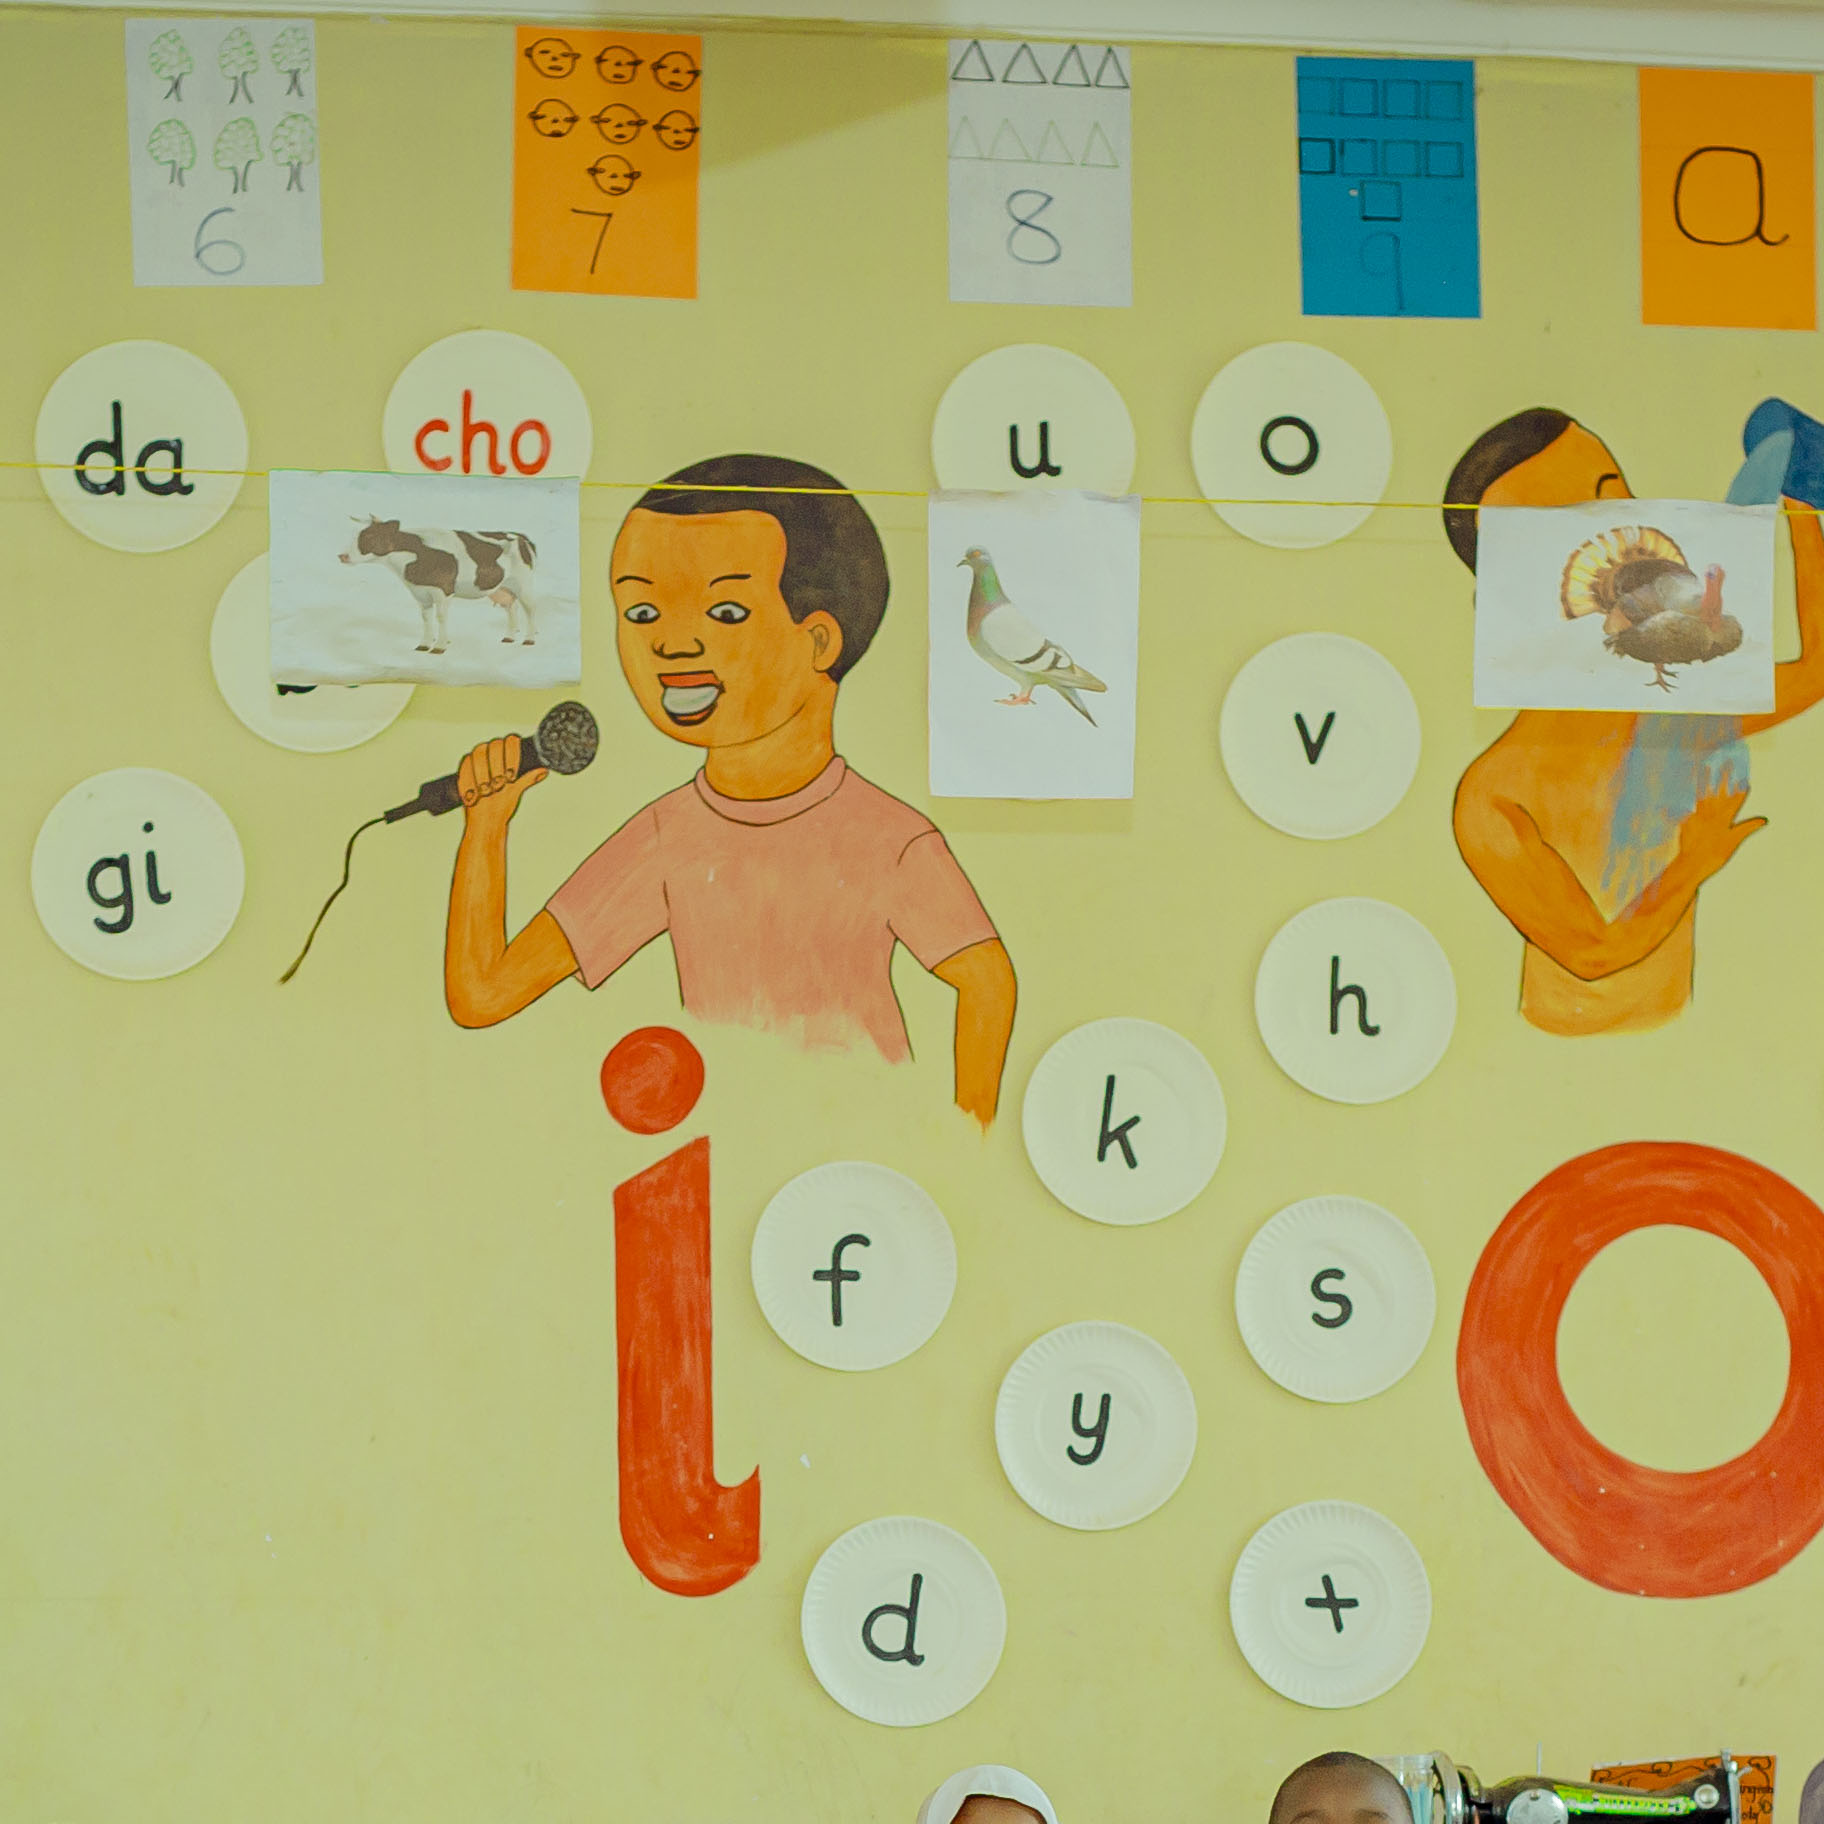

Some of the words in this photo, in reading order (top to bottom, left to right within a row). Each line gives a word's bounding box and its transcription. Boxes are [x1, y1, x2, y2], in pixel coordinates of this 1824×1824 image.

[1006, 189, 1061, 265] 8
[1673, 145, 1790, 246] a
[194, 206, 247, 276] 6
[571, 208, 614, 275] 7
[1361, 231, 1406, 311] 9
[73, 401, 194, 497] da
[413, 389, 552, 476] cho
[1009, 420, 1062, 479] u
[1260, 416, 1319, 475] o
[1294, 711, 1336, 765] v
[86, 821, 172, 935] gi
[1330, 955, 1381, 1037] h
[1097, 1074, 1141, 1169] k
[813, 1234, 870, 1327] f
[1311, 1267, 1353, 1329] s
[1066, 1392, 1111, 1467] y
[862, 1573, 924, 1666] d
